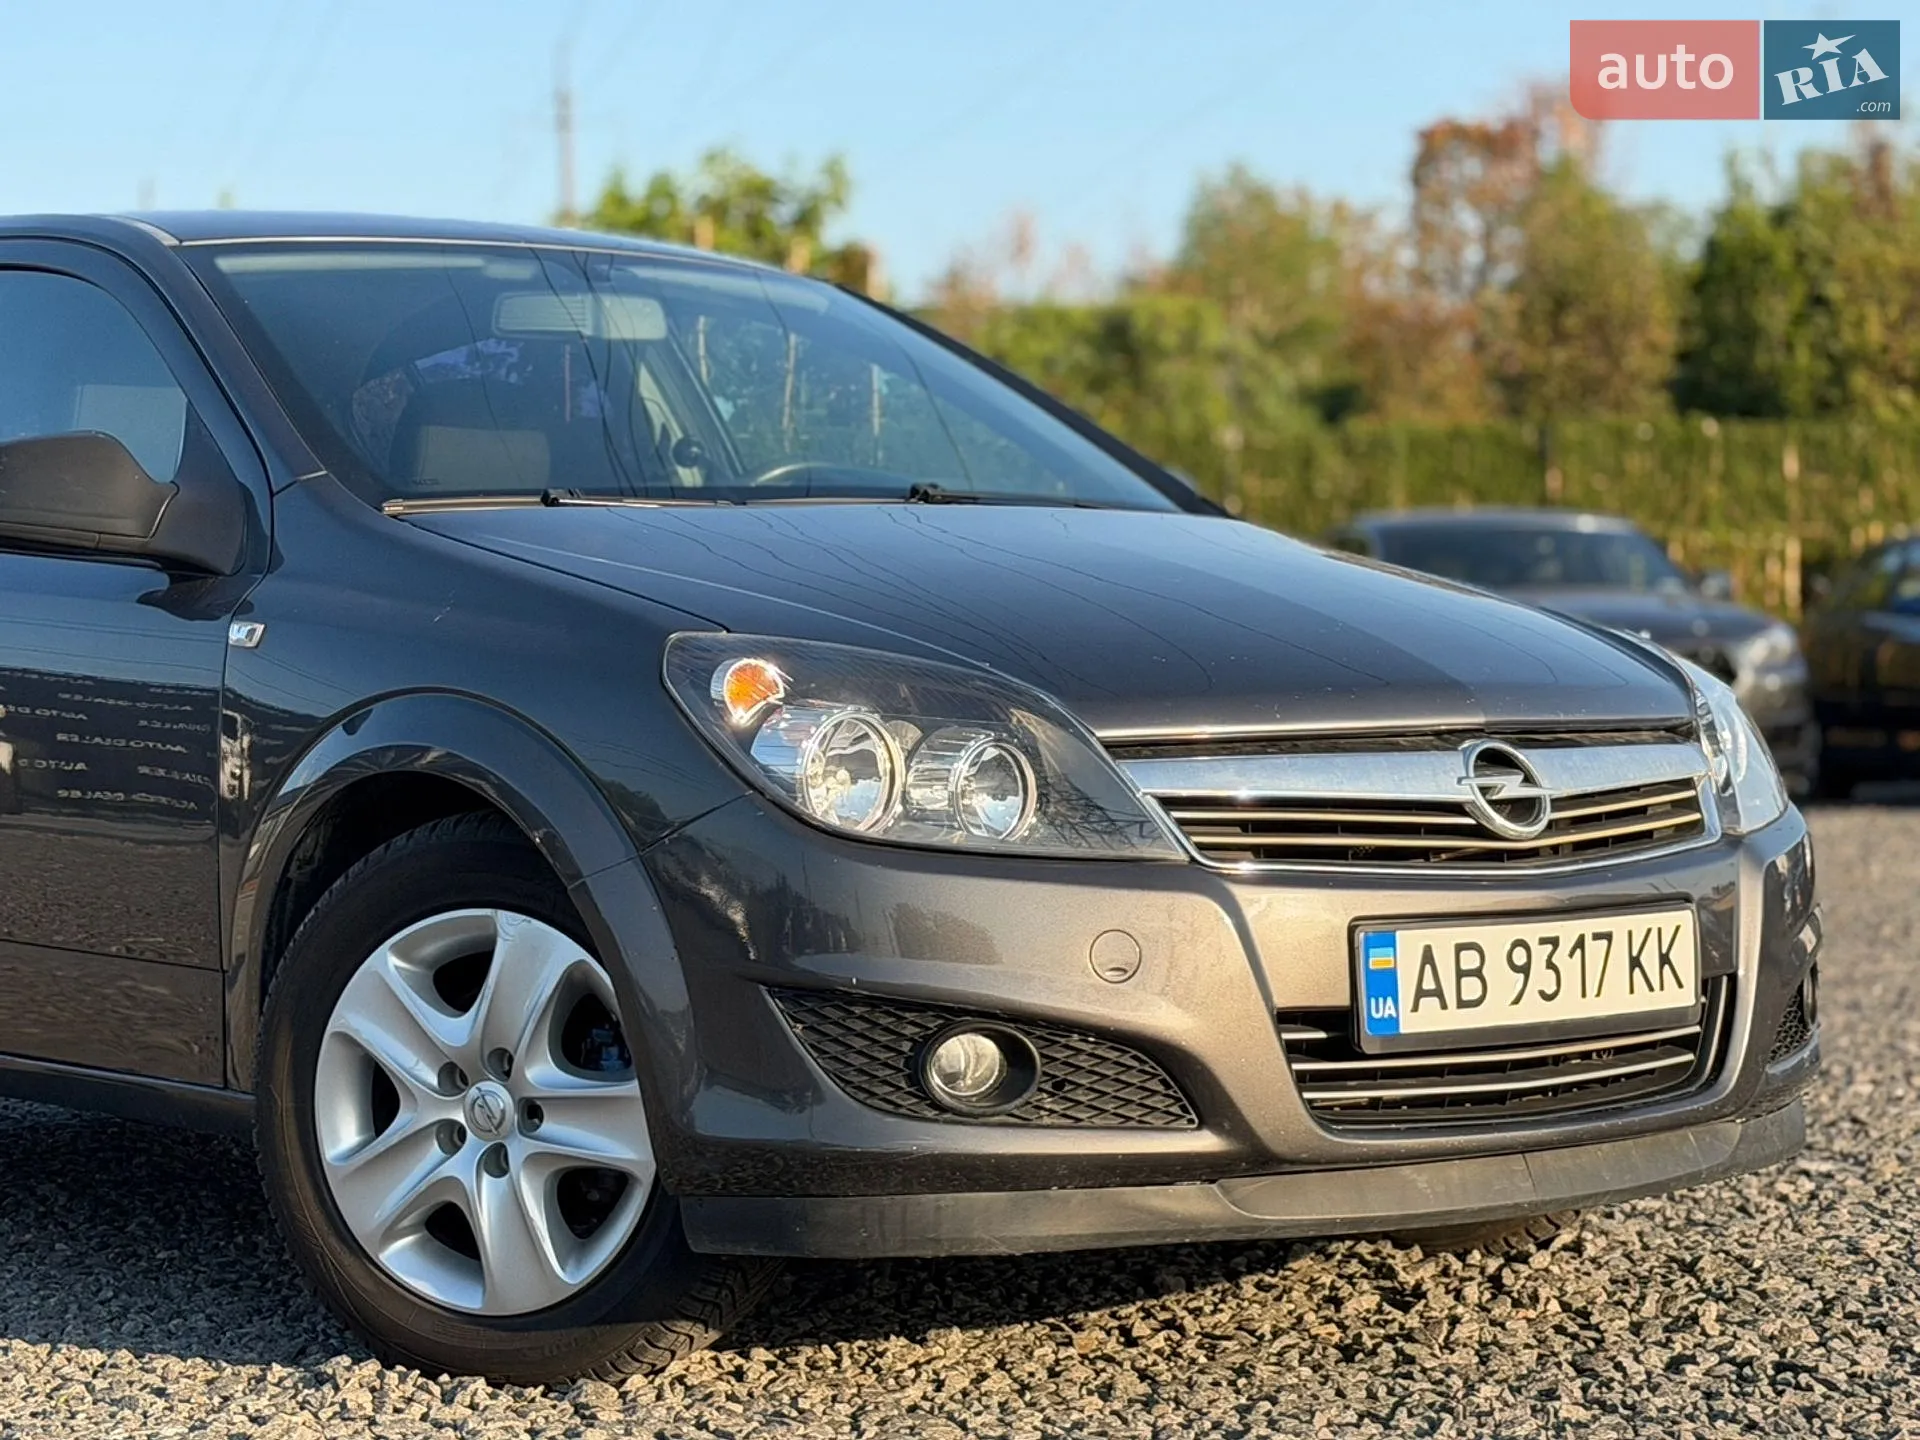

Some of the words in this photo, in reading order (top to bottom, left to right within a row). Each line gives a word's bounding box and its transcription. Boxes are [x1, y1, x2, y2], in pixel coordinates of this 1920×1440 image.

[1410, 941, 1488, 1013] AB
[1506, 930, 1613, 1006] 9317
[1627, 924, 1685, 995] KK
[1371, 997, 1397, 1019] UA
